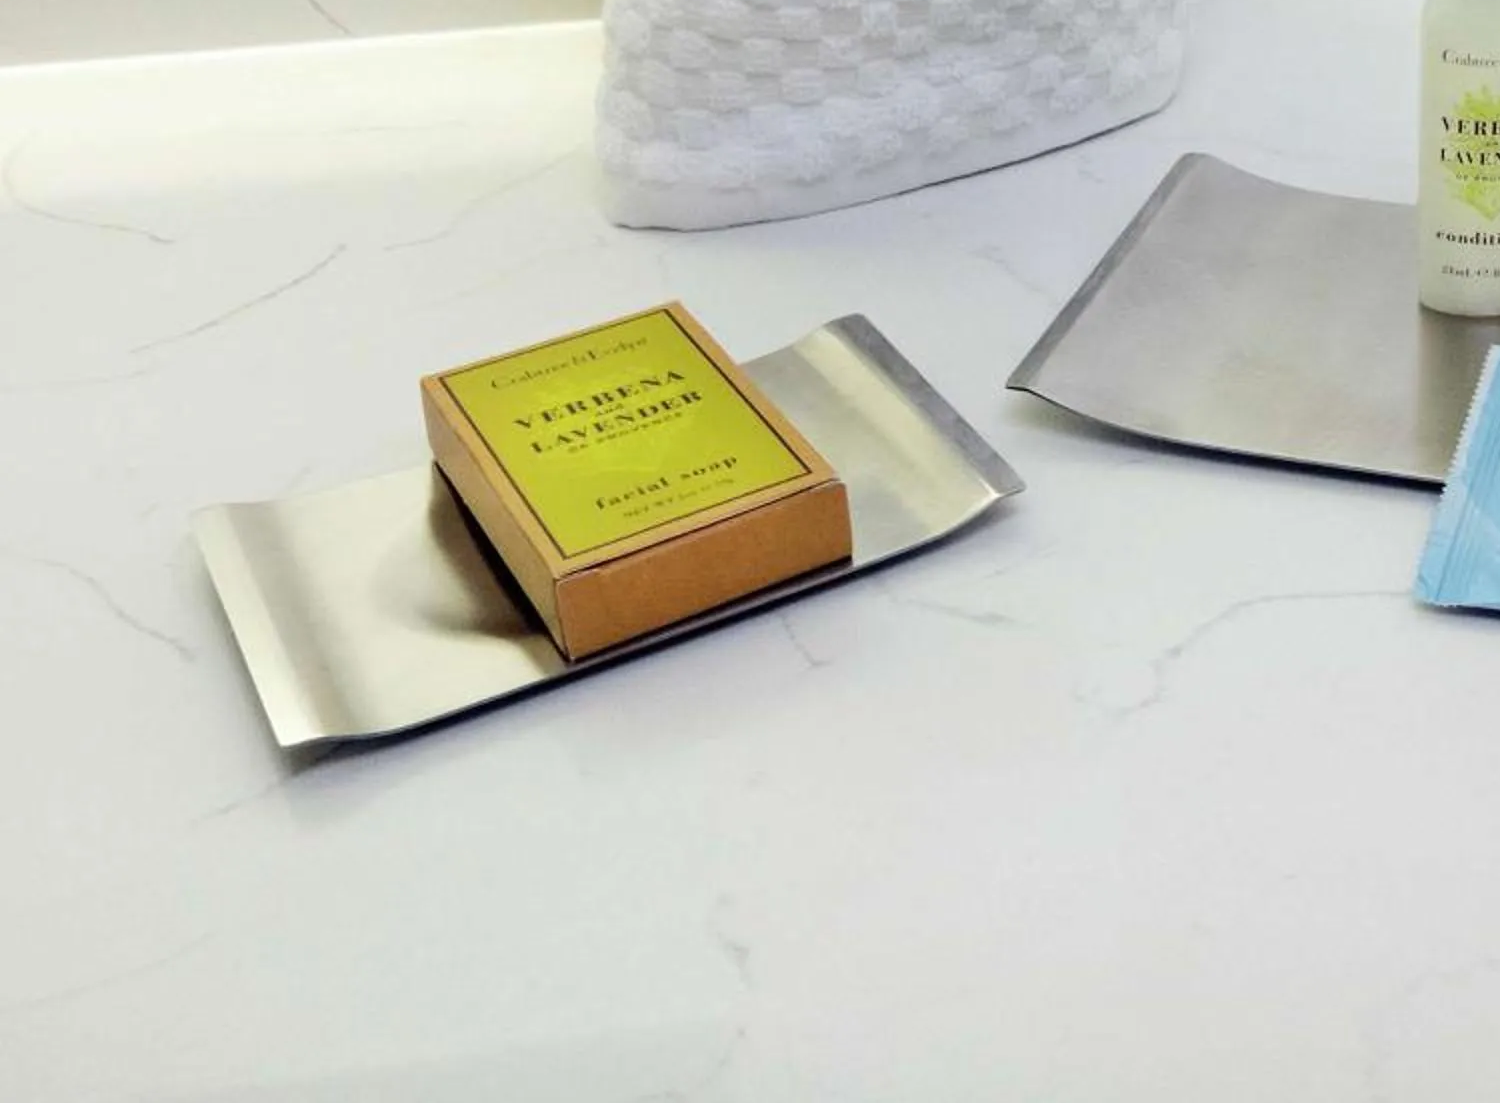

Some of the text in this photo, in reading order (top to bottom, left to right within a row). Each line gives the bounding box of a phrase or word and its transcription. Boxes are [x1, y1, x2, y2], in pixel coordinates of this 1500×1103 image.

[513, 369, 685, 429] VERBENA
[530, 391, 704, 454] LAVENDER
[596, 477, 670, 510] facial
[680, 456, 737, 480] soap
